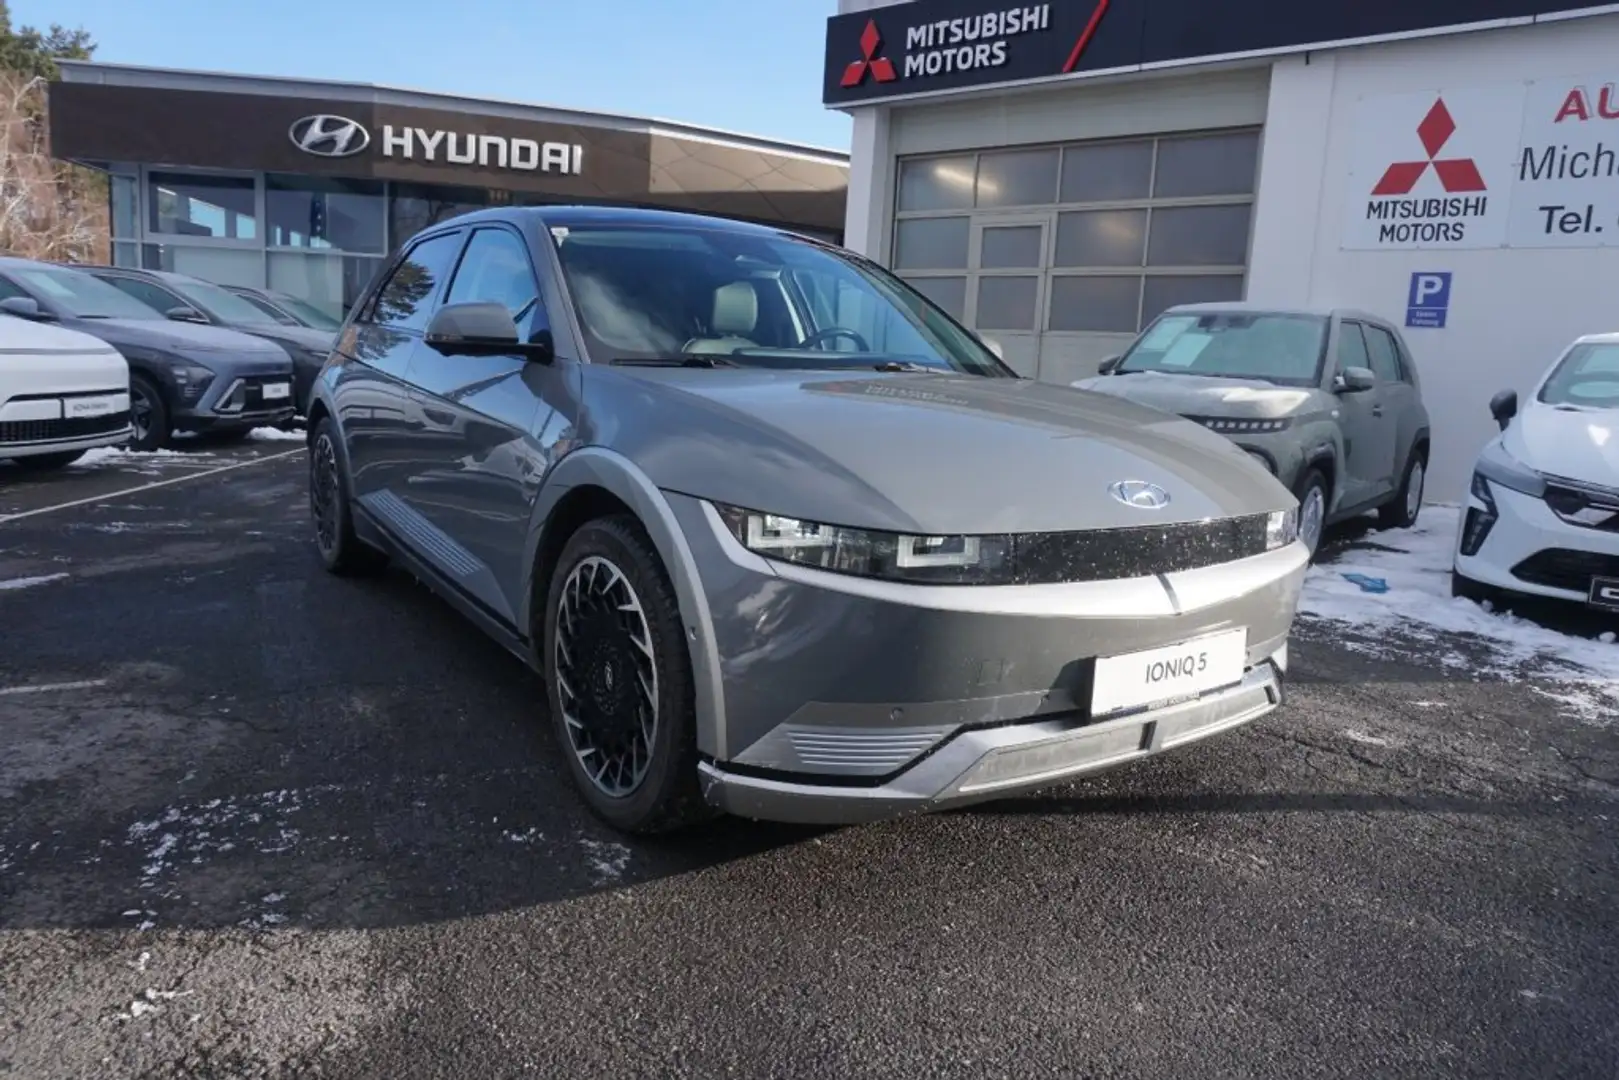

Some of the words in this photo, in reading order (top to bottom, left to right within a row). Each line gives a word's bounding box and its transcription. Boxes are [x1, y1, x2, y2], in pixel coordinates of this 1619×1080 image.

[906, 4, 1049, 49] MITSUBISHI
[904, 41, 1007, 77] MOTORS
[383, 124, 583, 175] HYUNDAI
[1519, 142, 1619, 181] Mich
[1366, 196, 1487, 220] MITSUBISHI
[1538, 204, 1603, 234] Tel.
[1379, 221, 1465, 243] MOTORS
[1415, 275, 1443, 305] P
[1145, 655, 1196, 684] IONIQ
[1198, 652, 1208, 671] 5
